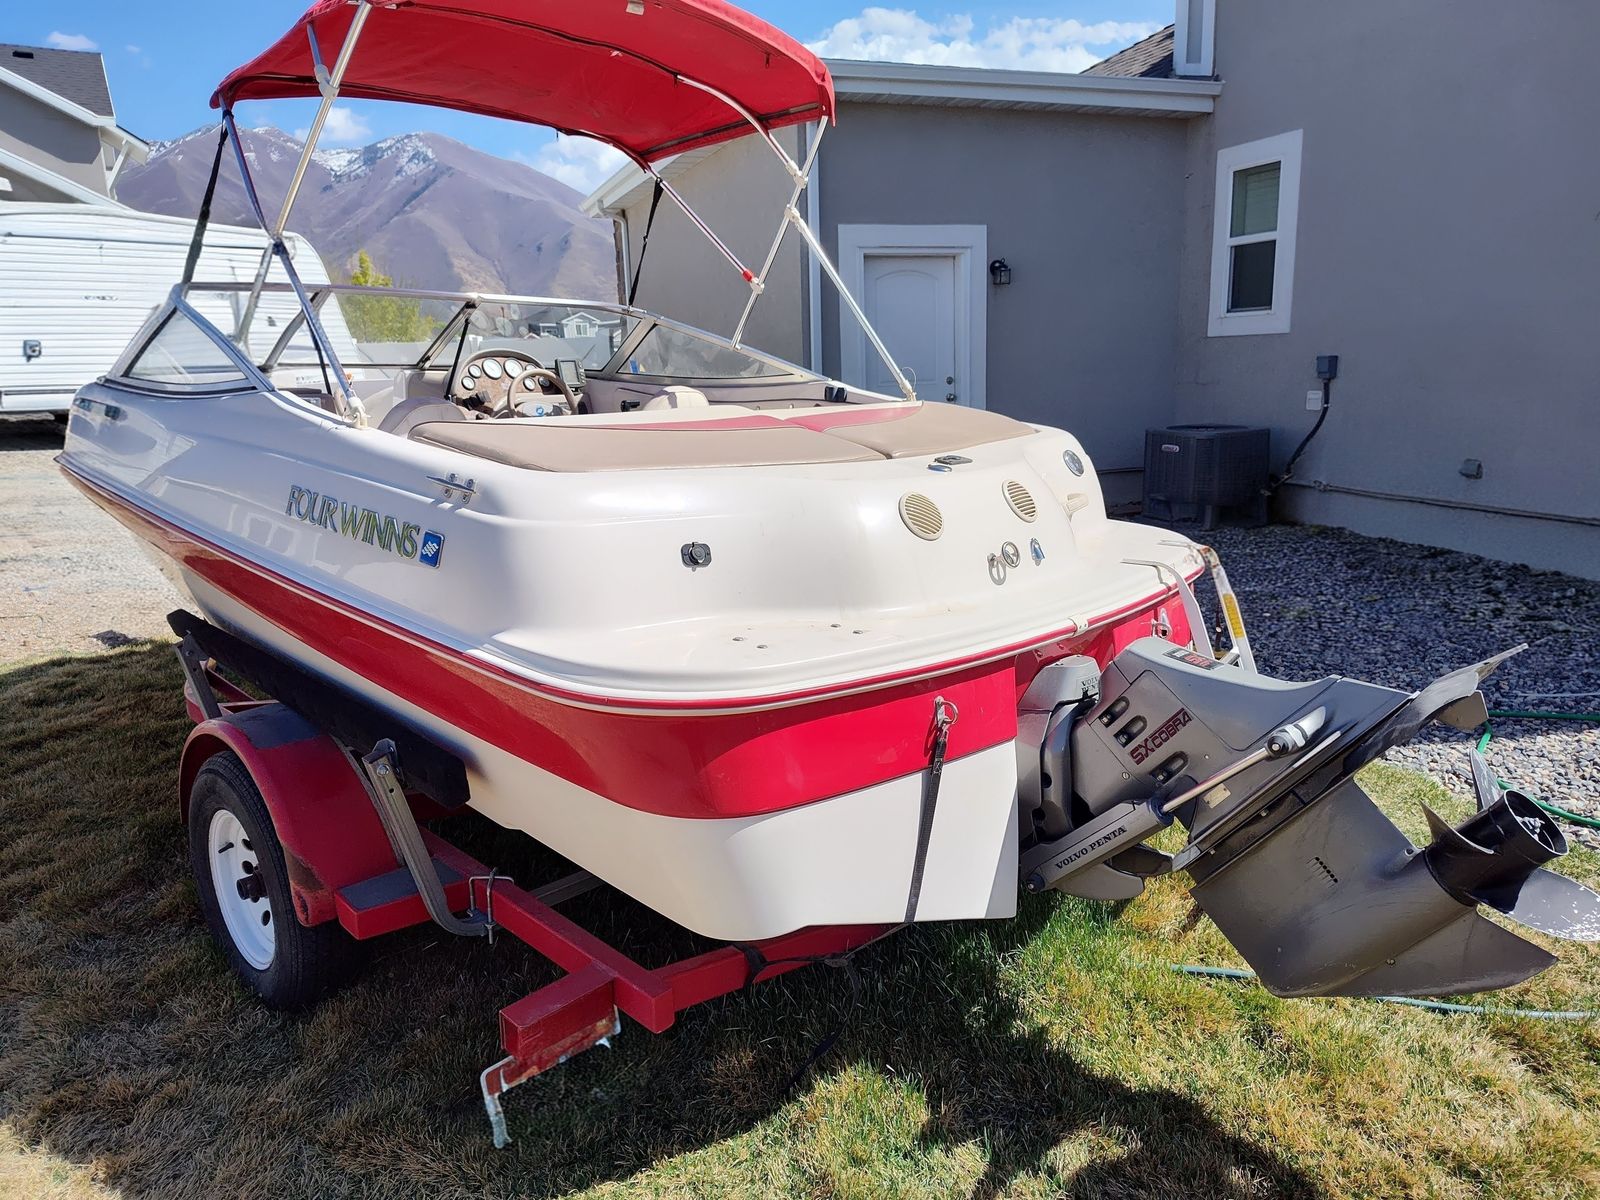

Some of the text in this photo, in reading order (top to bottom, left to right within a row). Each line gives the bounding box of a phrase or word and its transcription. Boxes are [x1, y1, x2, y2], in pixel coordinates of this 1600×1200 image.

[285, 485, 421, 559] FOUR WINNS
[1151, 710, 1193, 749] COBRA
[1055, 825, 1128, 870] VOLVO PENTA
